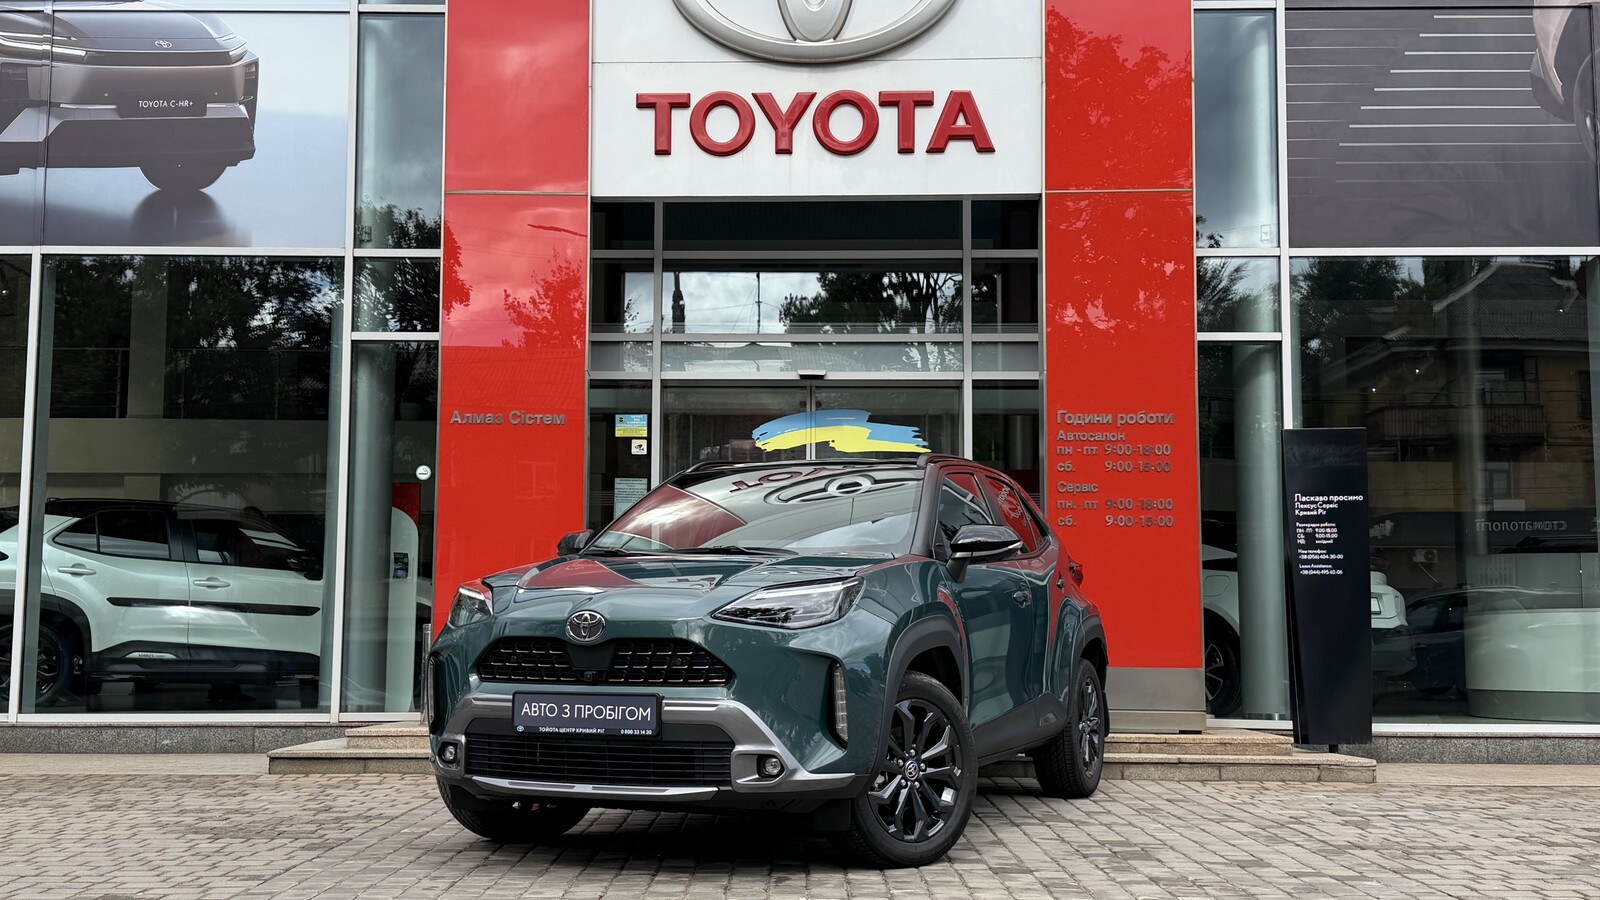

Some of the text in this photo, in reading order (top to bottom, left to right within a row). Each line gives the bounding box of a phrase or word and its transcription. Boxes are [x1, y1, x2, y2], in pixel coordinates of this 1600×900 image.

[138, 99, 193, 108] TOYOTA C-HR+
[636, 90, 996, 156] TOYOTA
[450, 410, 566, 425] Алмаз Сістем
[1056, 410, 1175, 427] Години роботи
[1057, 430, 1126, 441] Автосалон
[1056, 446, 1073, 455] пн
[1083, 446, 1098, 455] пт
[1057, 481, 1098, 494] Сервіс
[521, 702, 558, 717] АВТО
[574, 704, 652, 721] ПРОБІГОМ
